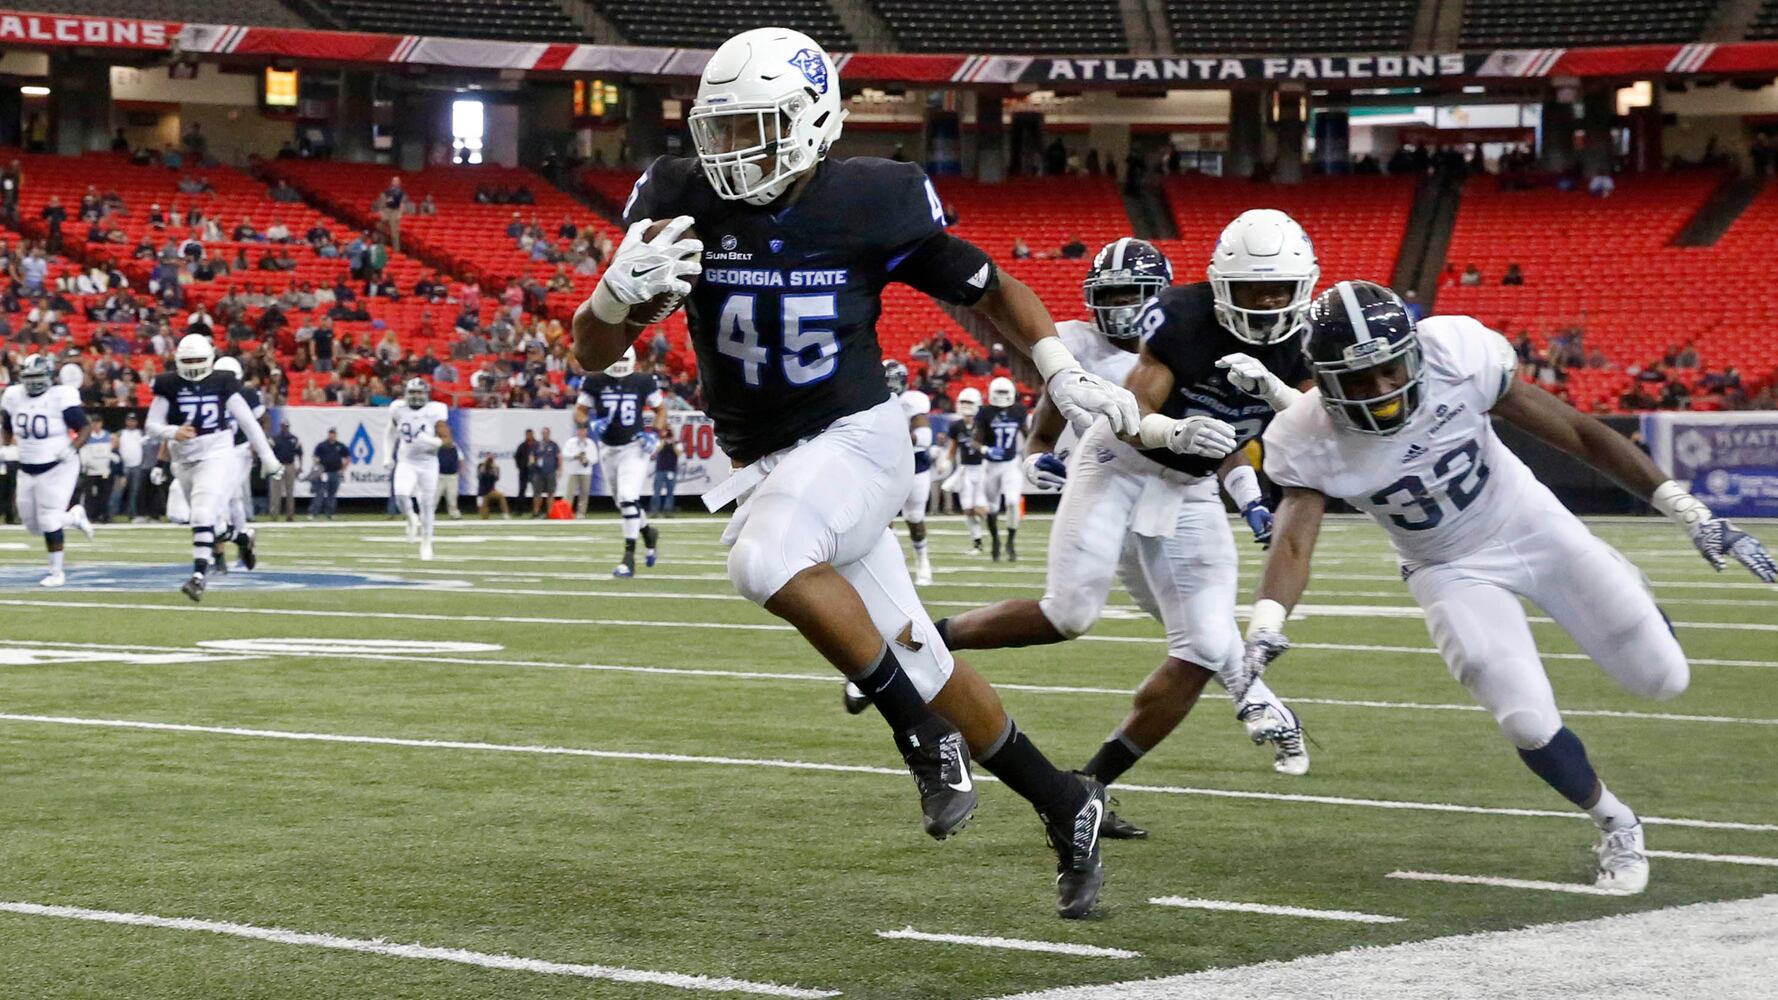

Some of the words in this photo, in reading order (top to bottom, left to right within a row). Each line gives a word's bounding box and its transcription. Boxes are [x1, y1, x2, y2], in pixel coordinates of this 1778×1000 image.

[1048, 58, 1246, 81] ATLANTA
[1262, 52, 1465, 79] FALCONS
[705, 268, 784, 286] GEORGIA
[790, 270, 847, 286] STATE
[717, 293, 839, 385] 45
[16, 413, 48, 439] 90
[178, 403, 220, 429] 72
[602, 401, 636, 426] 76
[680, 424, 714, 459] 40
[994, 428, 1017, 449] 17
[1370, 438, 1490, 531] 32
